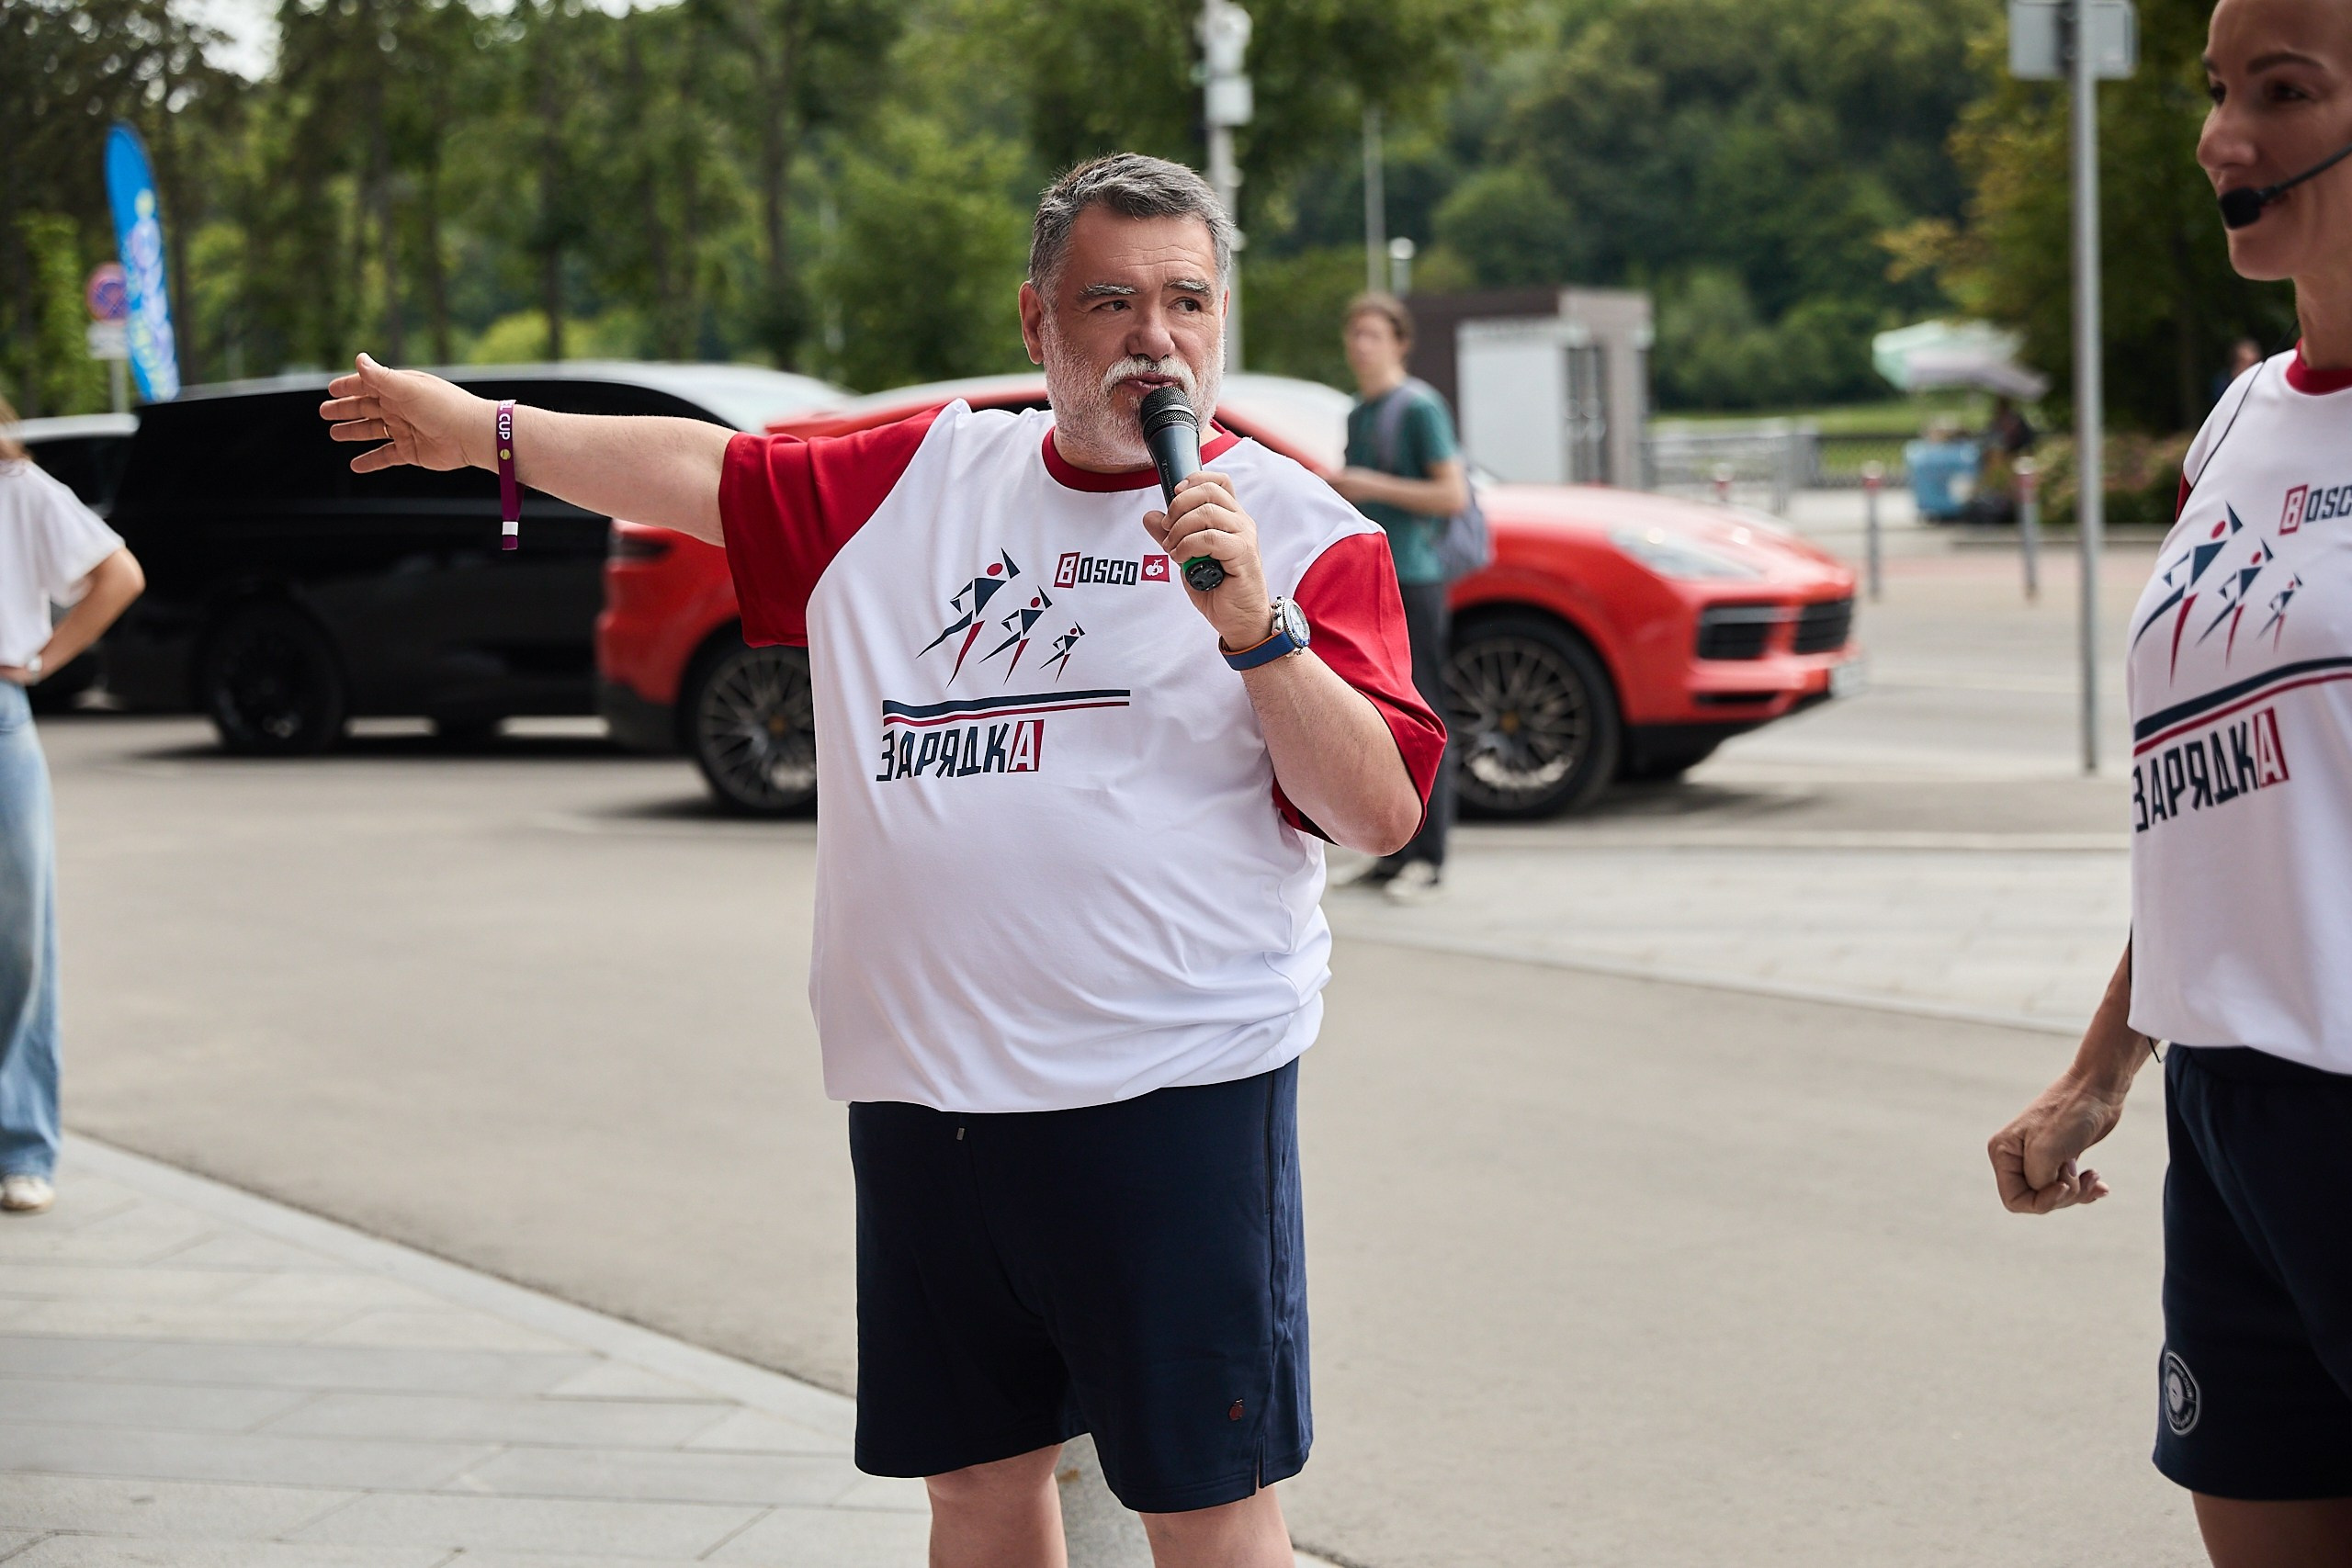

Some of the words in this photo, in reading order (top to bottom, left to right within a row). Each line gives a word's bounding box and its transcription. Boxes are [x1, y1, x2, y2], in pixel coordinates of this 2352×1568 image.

[499, 413, 511, 440] CUP
[1054, 551, 1139, 588] BOSCO
[876, 719, 1045, 781] ЗАРЯДКА
[2132, 706, 2290, 832] ЗАРЯДКА
